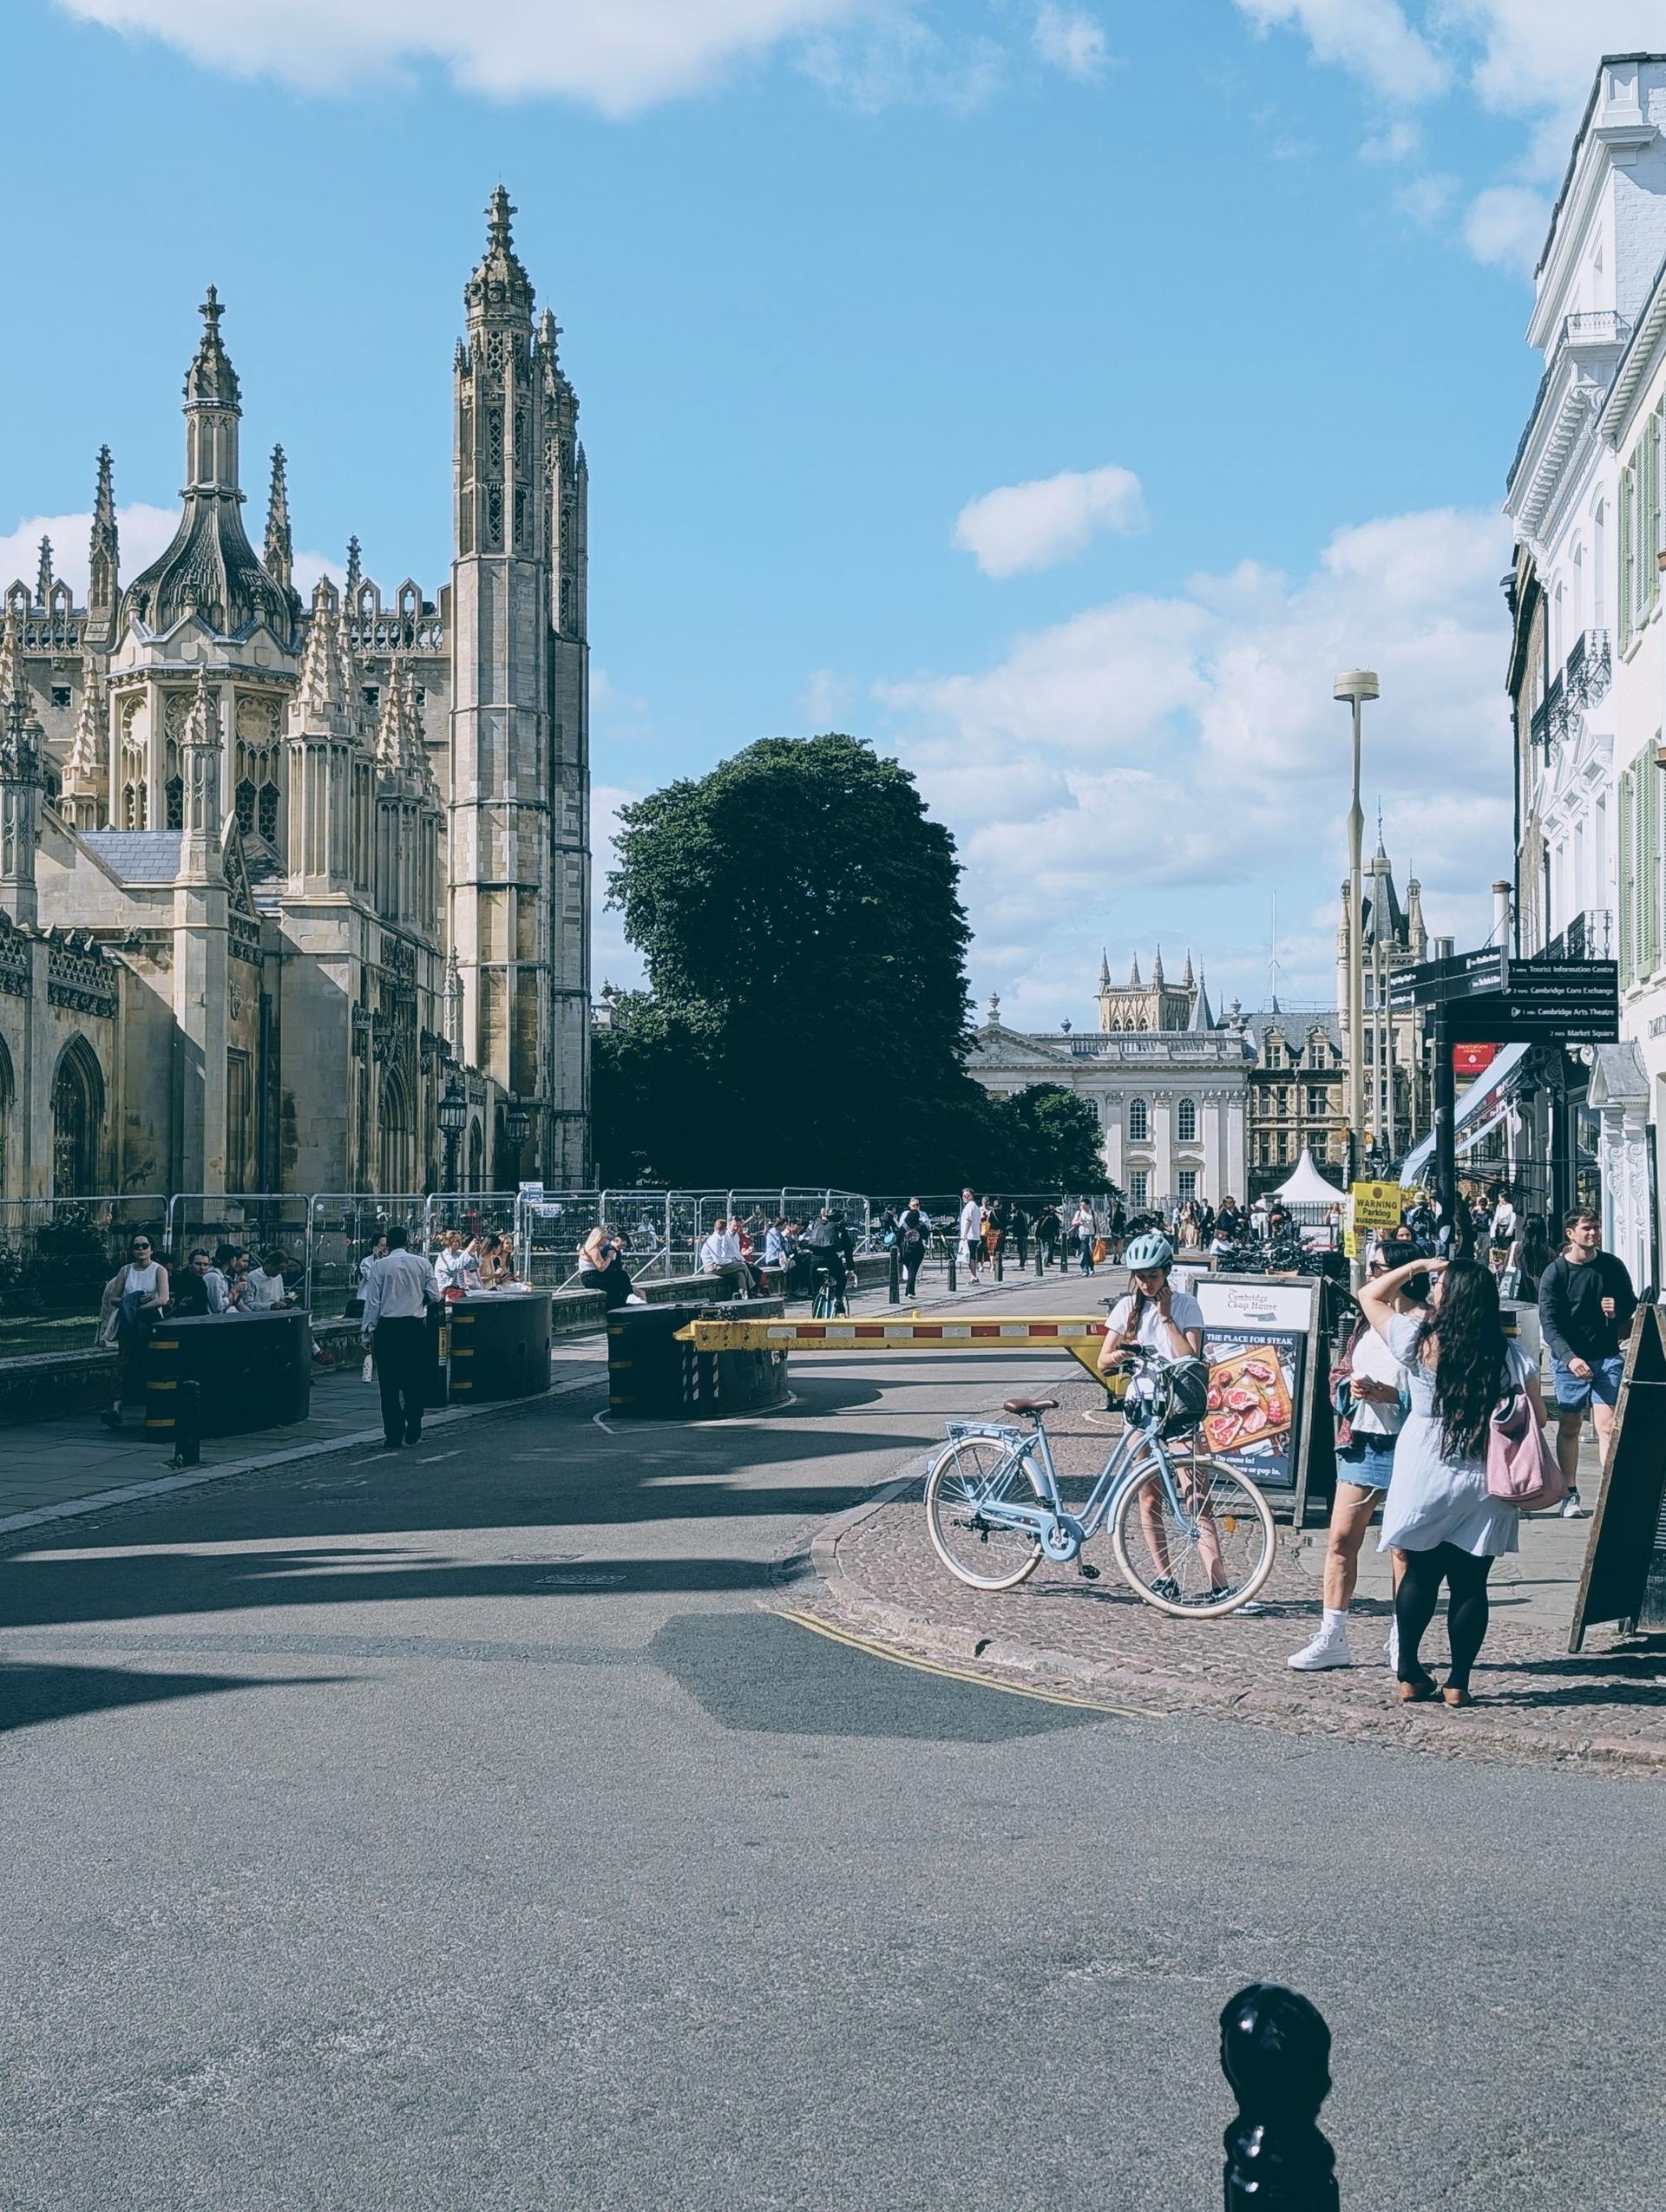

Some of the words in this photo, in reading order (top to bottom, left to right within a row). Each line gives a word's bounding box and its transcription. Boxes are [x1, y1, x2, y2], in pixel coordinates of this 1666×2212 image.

[1531, 987, 1565, 996] Cambridge
[1583, 987, 1614, 996] Exchange
[1538, 1008, 1572, 1017] Cambridge
[1591, 1030, 1615, 1038] Square
[1357, 1199, 1397, 1209] WARNING
[1363, 1208, 1391, 1219] Parking
[1228, 1293, 1269, 1303] Cambridge
[1227, 1300, 1250, 1311] Chop
[1251, 1301, 1277, 1311] House
[1223, 1334, 1249, 1344] PLACE
[1250, 1335, 1266, 1345] FOR
[1267, 1337, 1293, 1345] STEAK
[1256, 1468, 1271, 1476] pop
